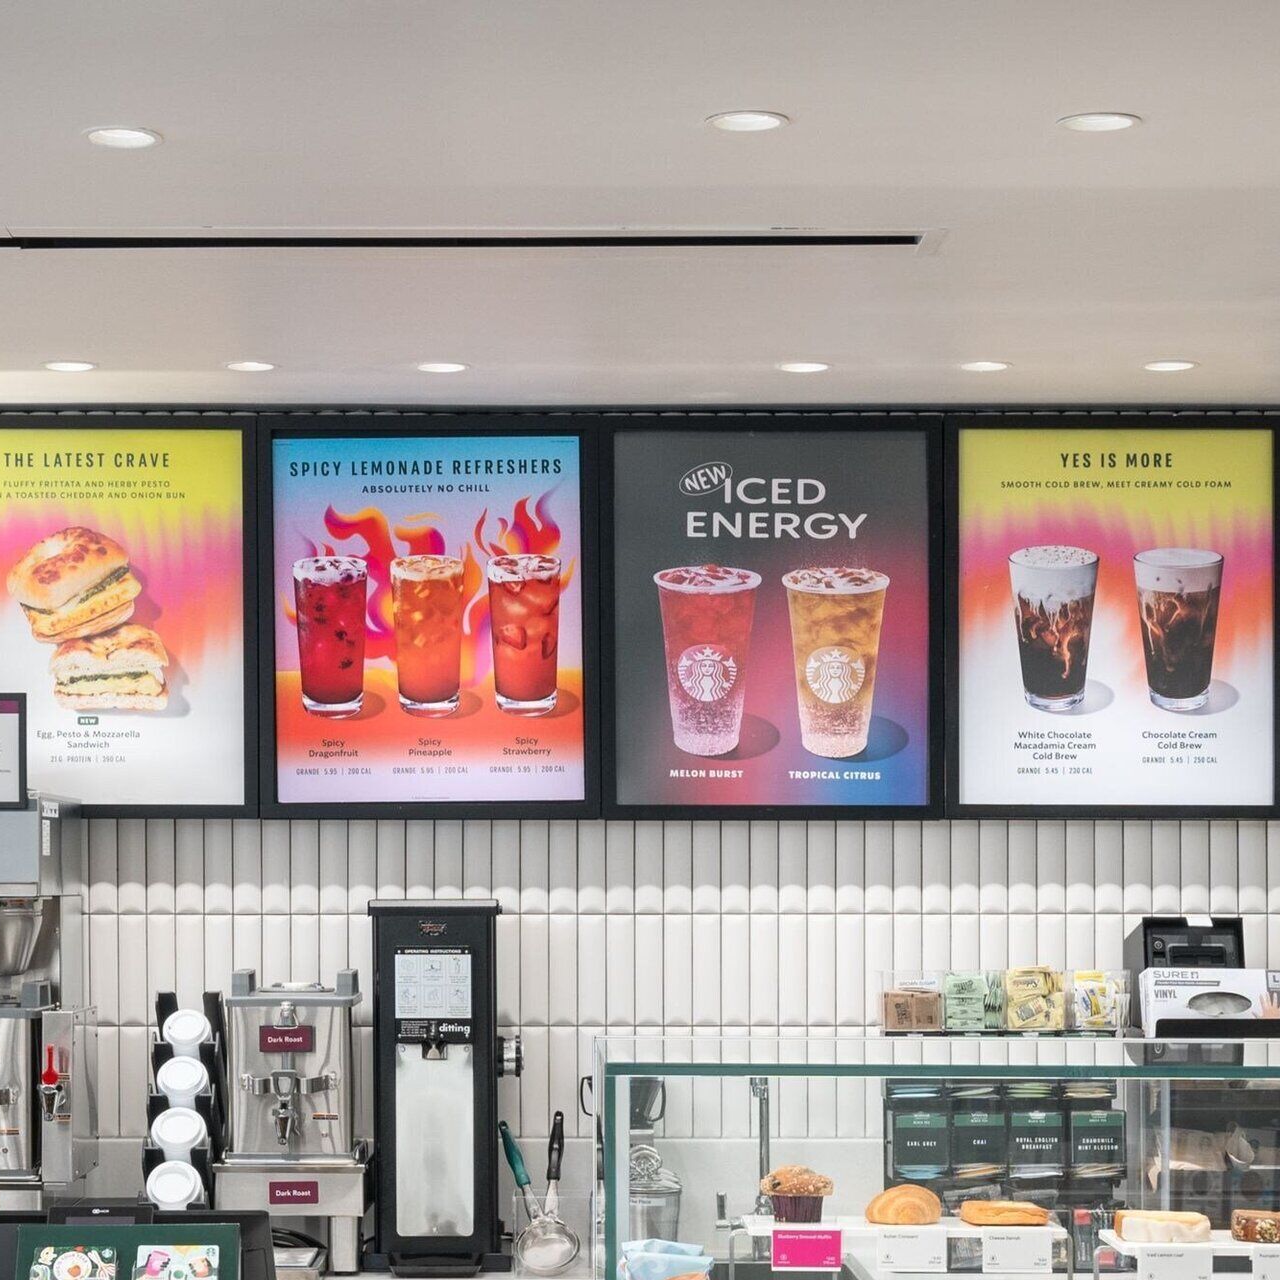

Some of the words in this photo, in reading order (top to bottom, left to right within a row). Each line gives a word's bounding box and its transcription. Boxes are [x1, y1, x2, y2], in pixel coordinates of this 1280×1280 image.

[4, 452, 34, 468] THE
[44, 452, 105, 468] LATEST
[114, 452, 170, 468] CRAVE
[1060, 453, 1092, 468] YES
[1100, 453, 1116, 468] IS
[1126, 453, 1173, 468] MORE
[290, 461, 342, 477] SPICY
[352, 460, 444, 476] LEMONADE
[452, 458, 562, 475] REFRESHERS
[684, 465, 727, 492] NEW
[362, 485, 433, 494] ABSOLUTELY
[438, 484, 454, 493] NO
[458, 483, 490, 492] CHILL
[724, 477, 827, 505] ICED
[686, 511, 868, 540] ENERGY
[36, 730, 54, 740] Egg,
[57, 730, 82, 738] Pesto
[84, 730, 90, 738] &
[93, 730, 140, 738] Mozzarella
[1018, 731, 1046, 740] White
[1047, 731, 1092, 740] Chocolate
[1142, 731, 1187, 740] Chocolate
[1188, 731, 1218, 740] Cream
[67, 740, 110, 748] Sandwich
[322, 738, 345, 749] Spicy
[418, 738, 442, 748] Spicy
[515, 736, 538, 746] Spicy
[1014, 742, 1066, 750] Macadamia
[1068, 742, 1096, 750] Cream
[1157, 742, 1178, 750] Cold
[1180, 742, 1202, 750] Brew
[308, 749, 358, 759] Dragonfruit
[408, 748, 452, 758] Pineapple
[502, 746, 552, 757] Strawberry
[1032, 752, 1053, 760] Cold
[1055, 752, 1077, 760] Brew
[670, 770, 706, 778] MELON
[708, 770, 744, 778] BURST
[789, 772, 841, 780] TROPICAL
[844, 772, 881, 780] CITRUS
[1272, 974, 1280, 982] L
[1154, 990, 1178, 1000] VINYL
[439, 1024, 470, 1034] ditting
[268, 1036, 284, 1044] Dark
[285, 1036, 303, 1044] Roast
[276, 1189, 292, 1197] Dark
[293, 1189, 311, 1197] Roast
